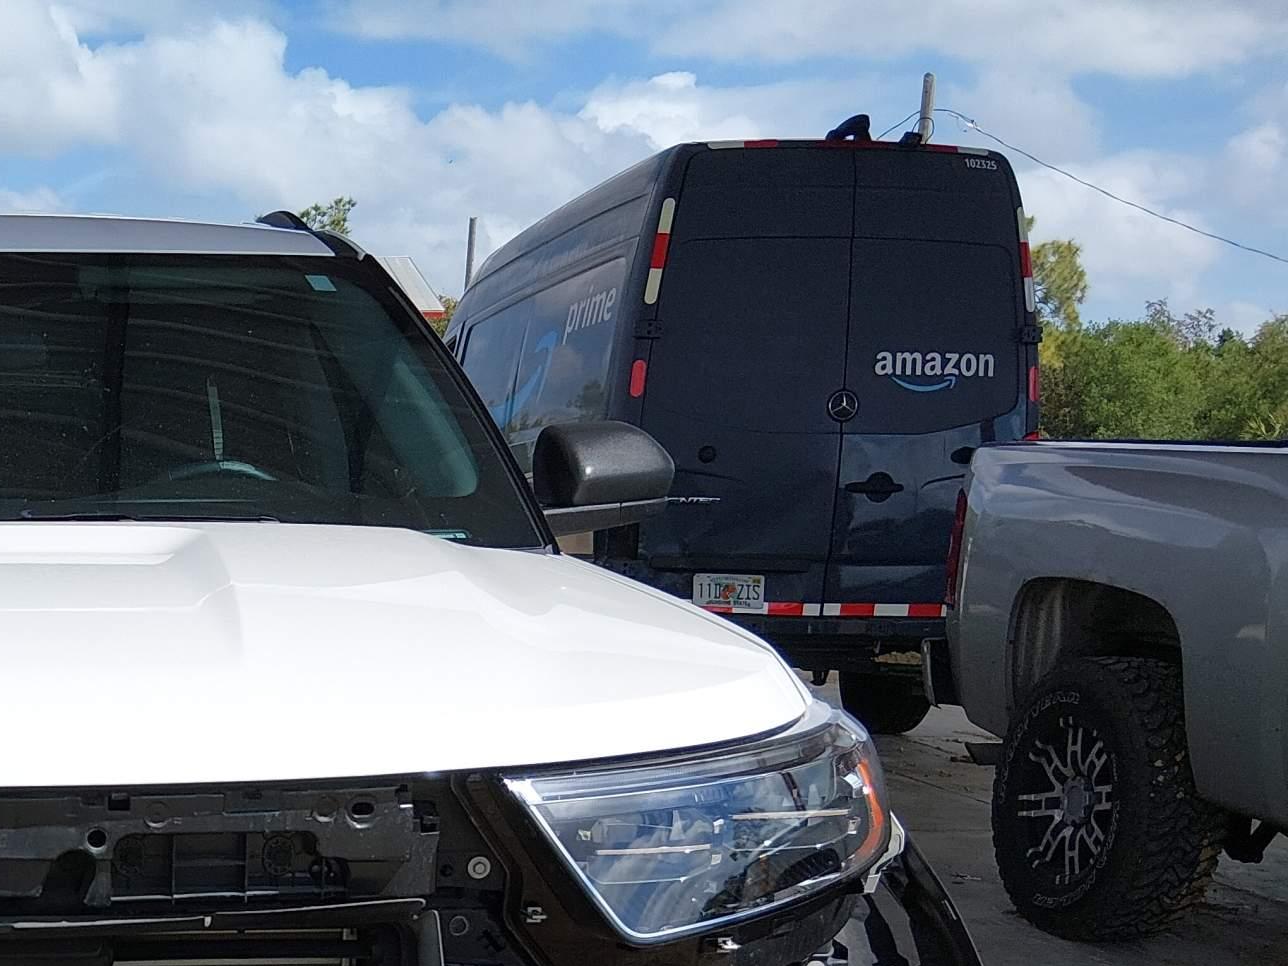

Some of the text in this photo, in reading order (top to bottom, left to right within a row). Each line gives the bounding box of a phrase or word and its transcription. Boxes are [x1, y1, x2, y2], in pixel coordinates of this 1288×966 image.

[562, 285, 617, 345] prime
[874, 350, 995, 377] amazon
[736, 583, 761, 601] ZIS
